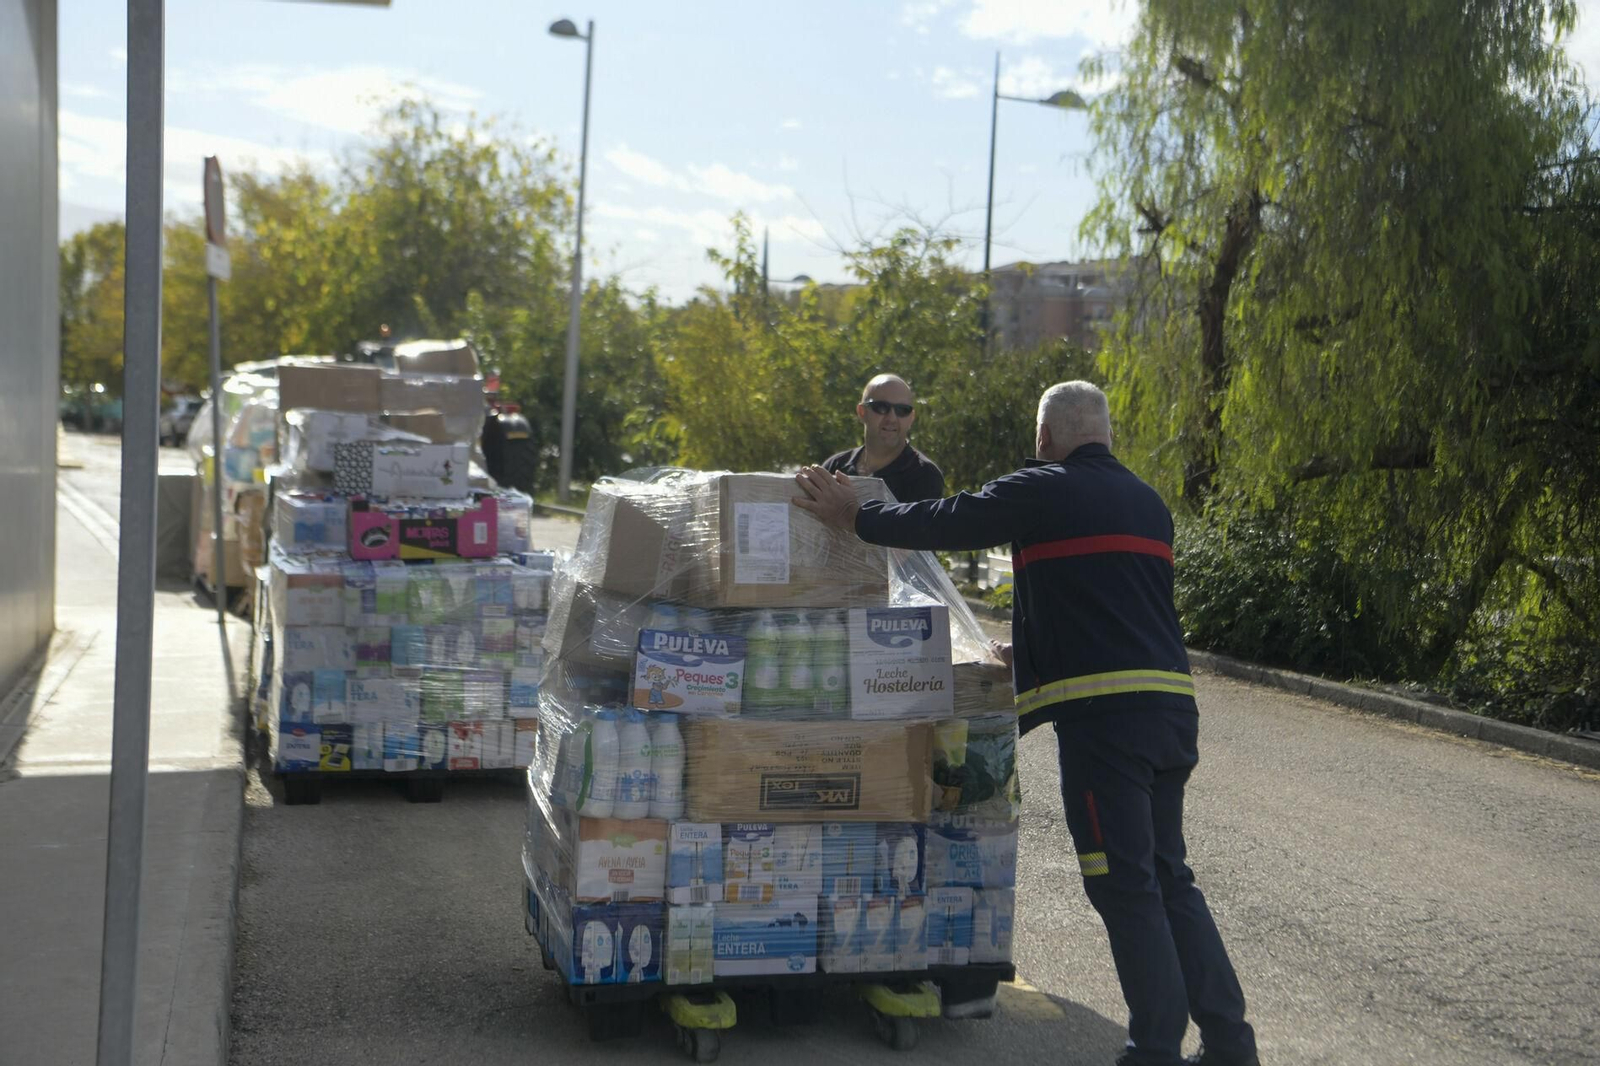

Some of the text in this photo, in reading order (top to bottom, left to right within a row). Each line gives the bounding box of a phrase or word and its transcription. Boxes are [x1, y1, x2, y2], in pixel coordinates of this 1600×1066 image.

[871, 619, 928, 632] PULEVA
[654, 632, 729, 656] PULEVA
[675, 669, 739, 689] Peques 3
[876, 667, 908, 679] Leche
[863, 676, 945, 694] Hostelería
[351, 693, 378, 701] TERA
[816, 789, 850, 803] MK
[737, 823, 768, 831] PULEVA
[680, 831, 708, 839] ENTERA
[762, 847, 770, 858] 3
[937, 896, 963, 904] ENTERA
[718, 943, 766, 955] ENTERA
